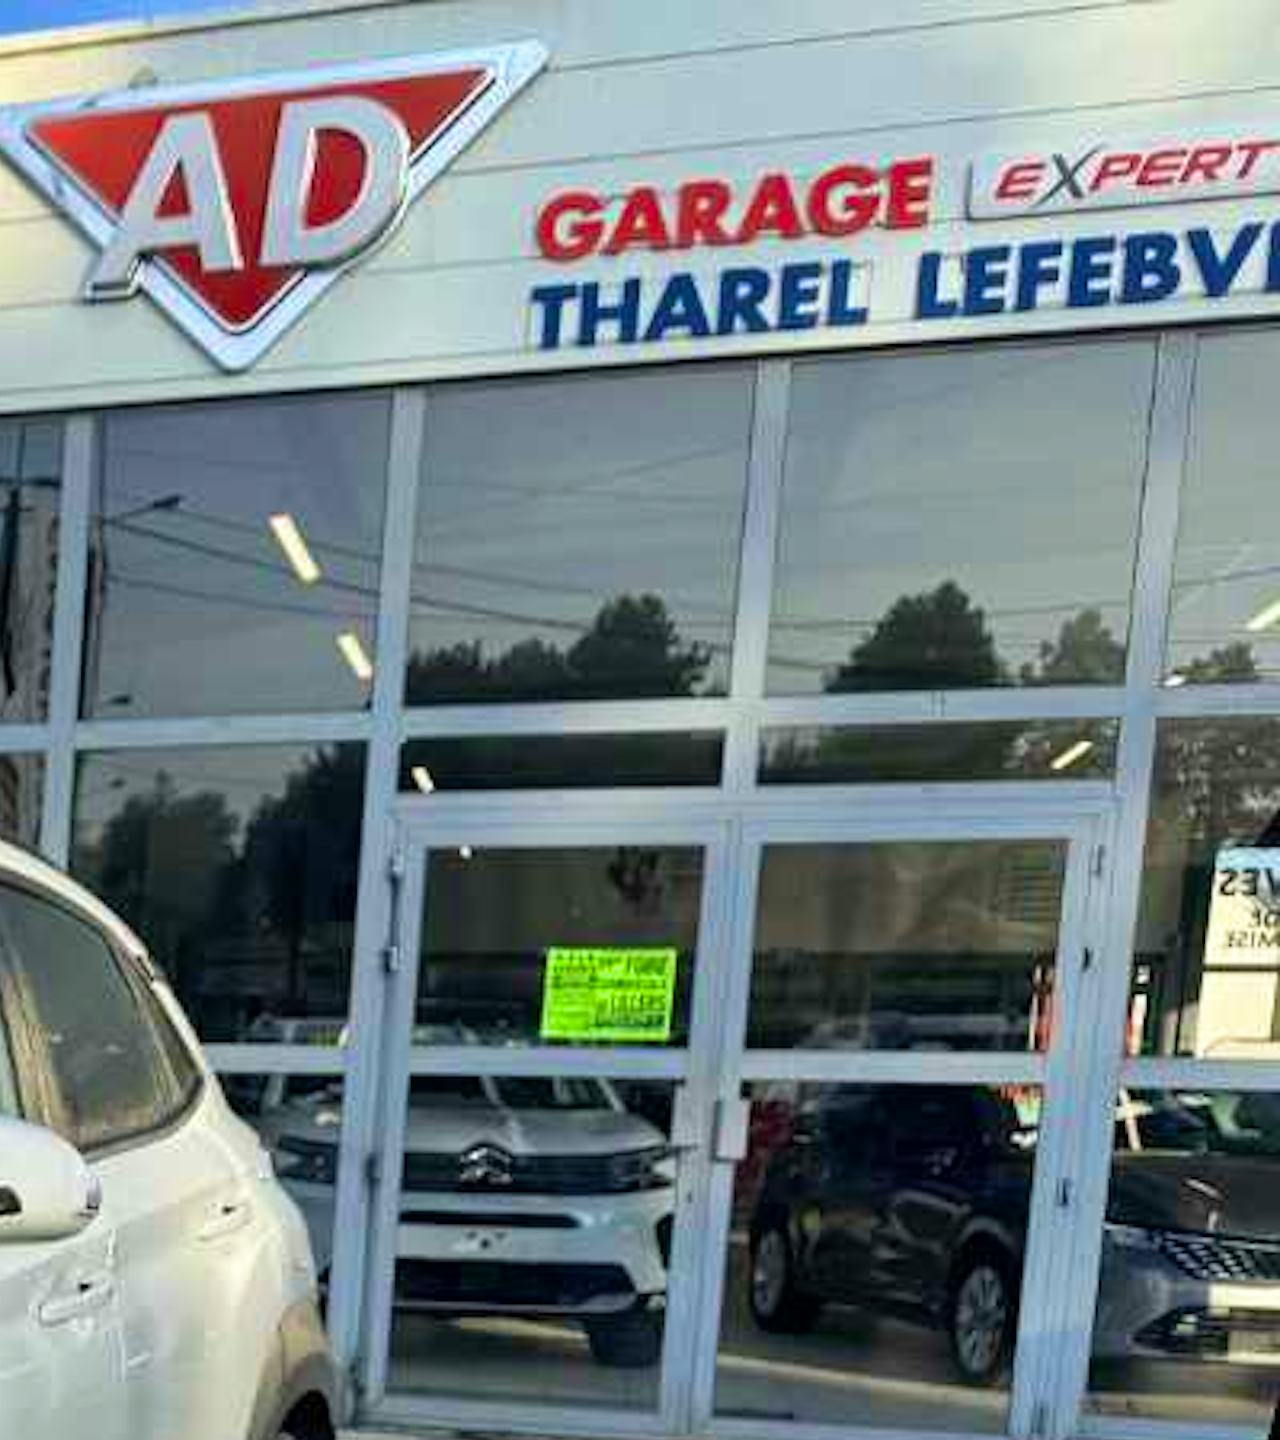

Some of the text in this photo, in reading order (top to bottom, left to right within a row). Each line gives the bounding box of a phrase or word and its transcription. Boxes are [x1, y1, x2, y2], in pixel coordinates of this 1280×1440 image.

[82, 94, 412, 299] AD
[536, 157, 933, 262] GARAGE
[995, 139, 1280, 207] EXPERT
[530, 258, 869, 349] THAREL
